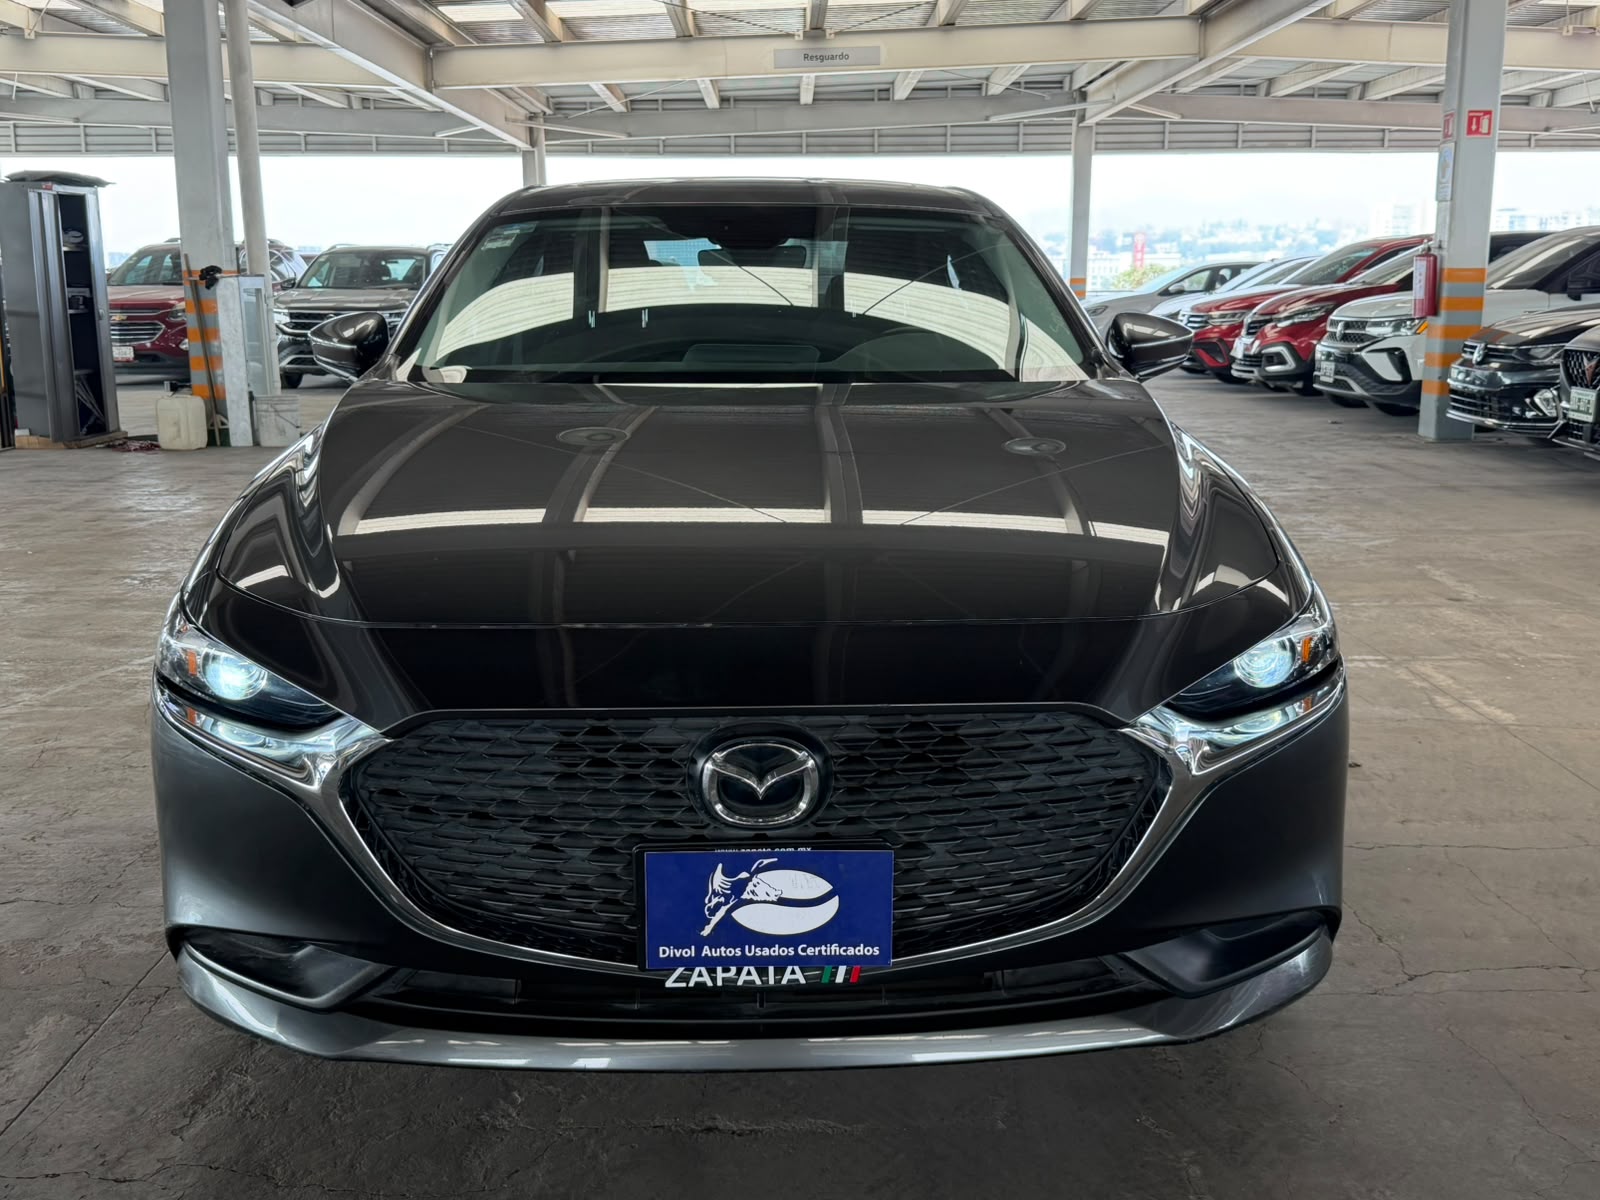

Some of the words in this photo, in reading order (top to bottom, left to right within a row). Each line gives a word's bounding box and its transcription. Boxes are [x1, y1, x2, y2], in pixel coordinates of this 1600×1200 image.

[803, 52, 850, 63] Resguardo
[659, 946, 695, 958] Divol
[701, 945, 742, 957] Autos
[744, 944, 795, 956] Usados
[798, 944, 880, 956] Certificados
